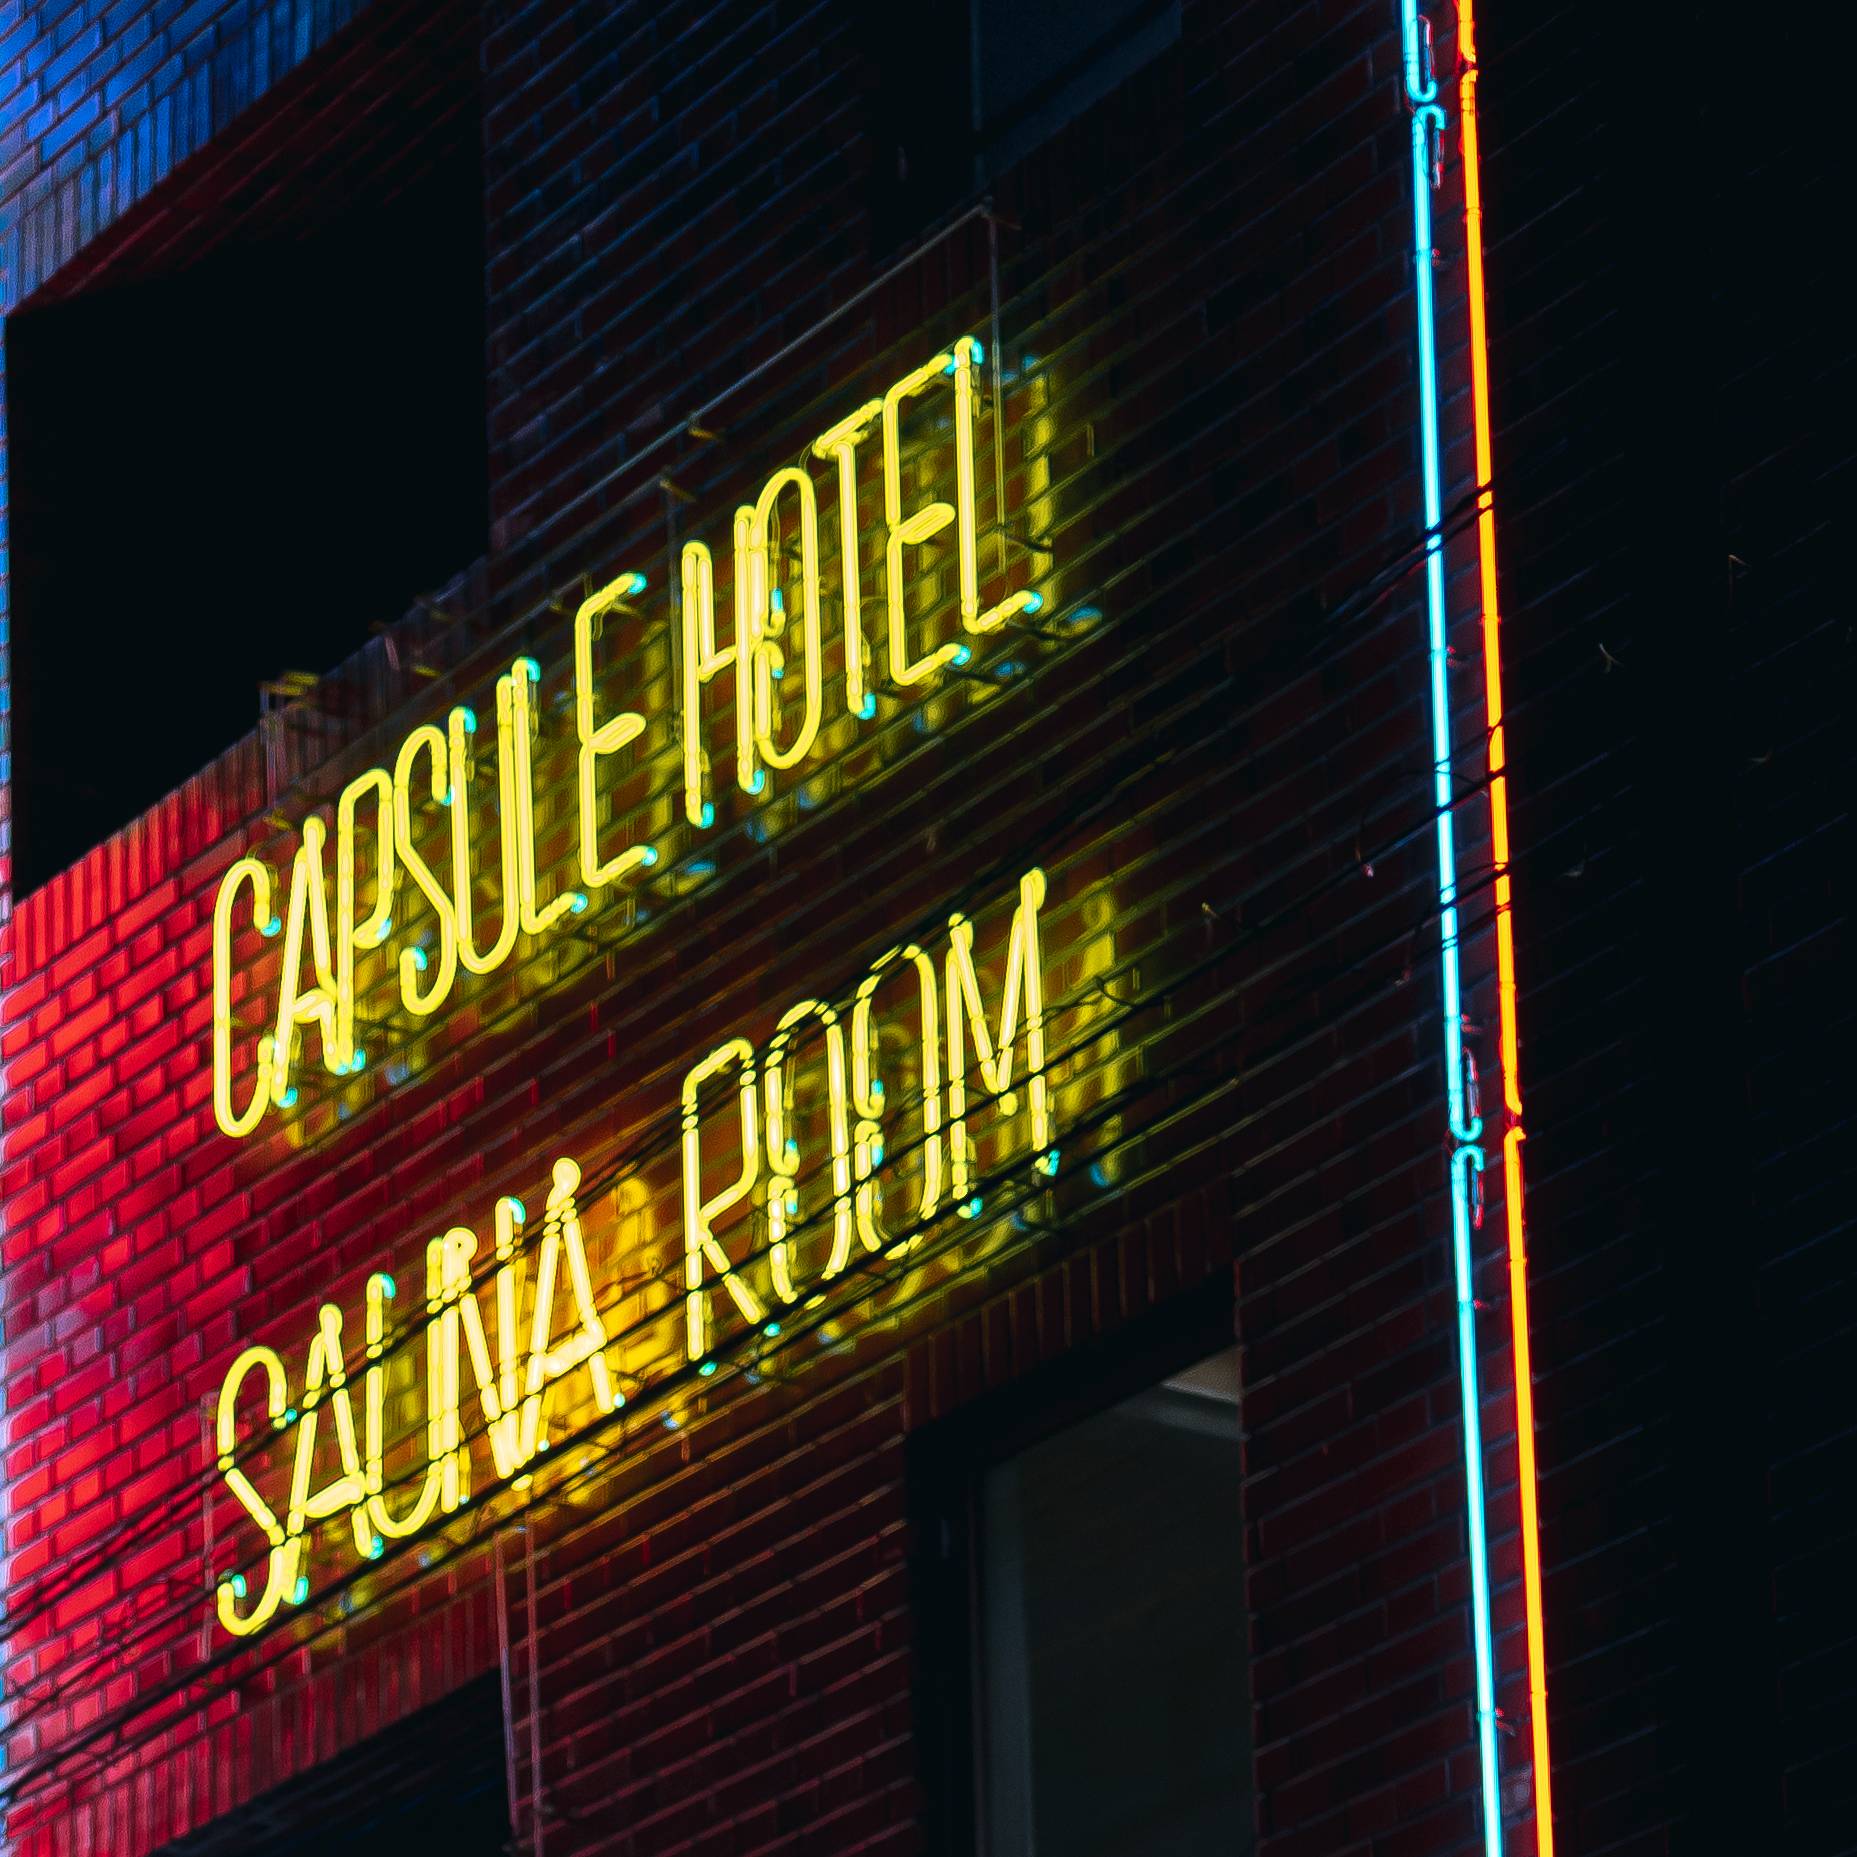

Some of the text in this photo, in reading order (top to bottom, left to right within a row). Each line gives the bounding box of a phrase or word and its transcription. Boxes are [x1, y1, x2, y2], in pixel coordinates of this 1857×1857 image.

[213, 337, 1043, 1137] CAPSULE HOTEL
[217, 866, 1060, 1639] SAUNA ROOM
